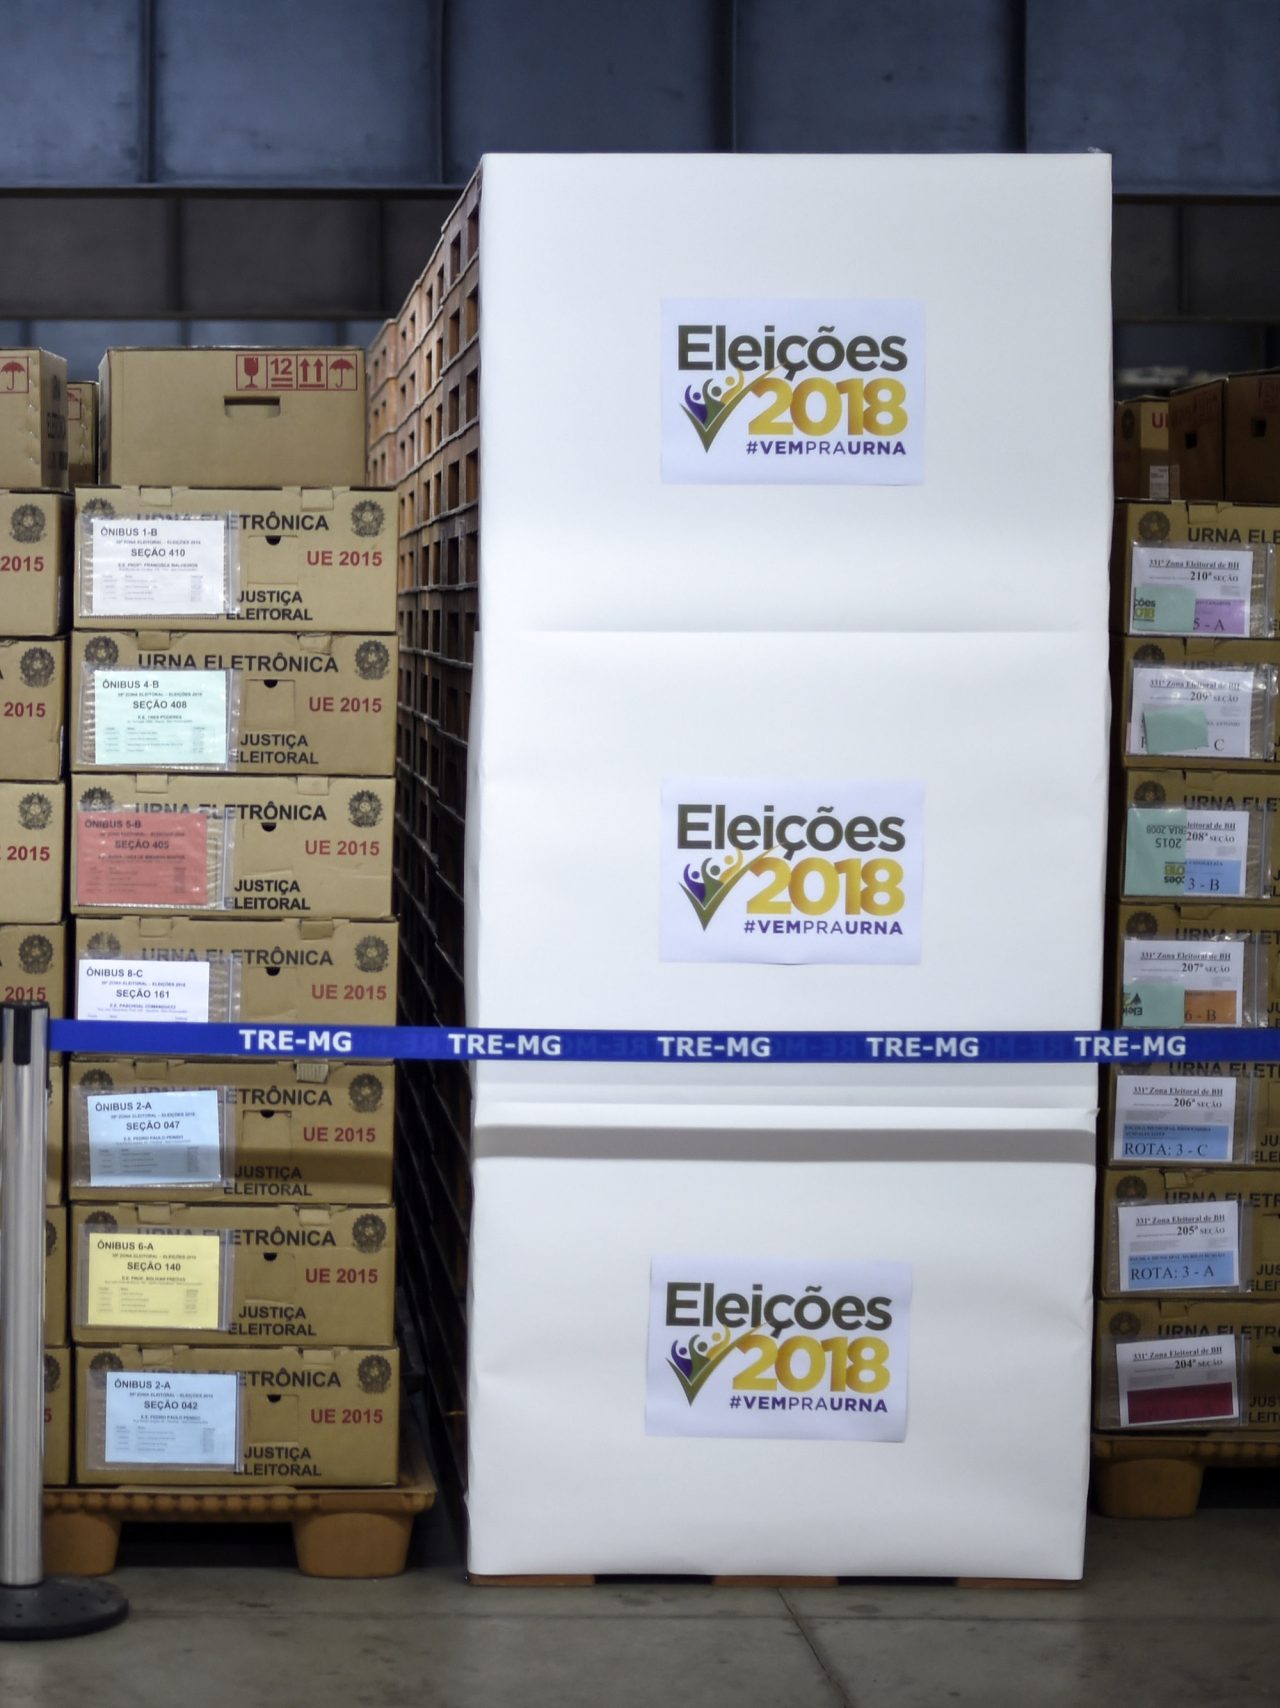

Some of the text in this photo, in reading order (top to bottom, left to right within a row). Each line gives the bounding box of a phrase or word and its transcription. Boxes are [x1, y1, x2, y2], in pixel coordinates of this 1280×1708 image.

[678, 325, 908, 381] Eleições
[271, 358, 292, 375] 12
[748, 377, 908, 436] 2018
[746, 441, 906, 455] #VEMPRAURNA
[1188, 528, 1242, 543] URNA
[131, 548, 185, 558] SEÇÃO 410
[307, 551, 382, 566] UE 2015
[102, 680, 159, 689] ÔNIBUS 4-B
[4, 702, 45, 717] 2015
[133, 700, 187, 710] SEÇÃO 408
[240, 734, 307, 748] JUSTIÇA
[678, 804, 906, 860] Eleições
[115, 840, 169, 850] SEÇÃO 405
[7, 846, 49, 860] 2015
[235, 880, 300, 893] JUSTIÇA
[746, 856, 905, 916] 2018
[744, 920, 903, 934] #VEMPRAURNA
[116, 989, 170, 999] SEÇÃO 161
[239, 1029, 352, 1052] TRE-MG
[448, 1034, 562, 1056] TRE-MG
[658, 1036, 771, 1058] TRE-MG
[866, 1036, 980, 1058] TRE-MG
[1074, 1036, 1186, 1057] TRE-MG
[126, 1120, 180, 1131] SEÇÃO 047
[303, 1127, 375, 1142] UE 2015
[1124, 1143, 1208, 1156] ROTA: 3 C
[127, 1262, 181, 1272] SEÇÃO 140
[1131, 1267, 1214, 1280] ROTA: 3 A
[666, 1282, 892, 1338] Eleições
[732, 1334, 890, 1393] 2018
[114, 1380, 171, 1389] ÔNIBUS 2-A
[144, 1400, 198, 1411] SEÇÃO 042
[730, 1395, 888, 1412] #VEMPRAURNA
[310, 1409, 383, 1424] UE 2015
